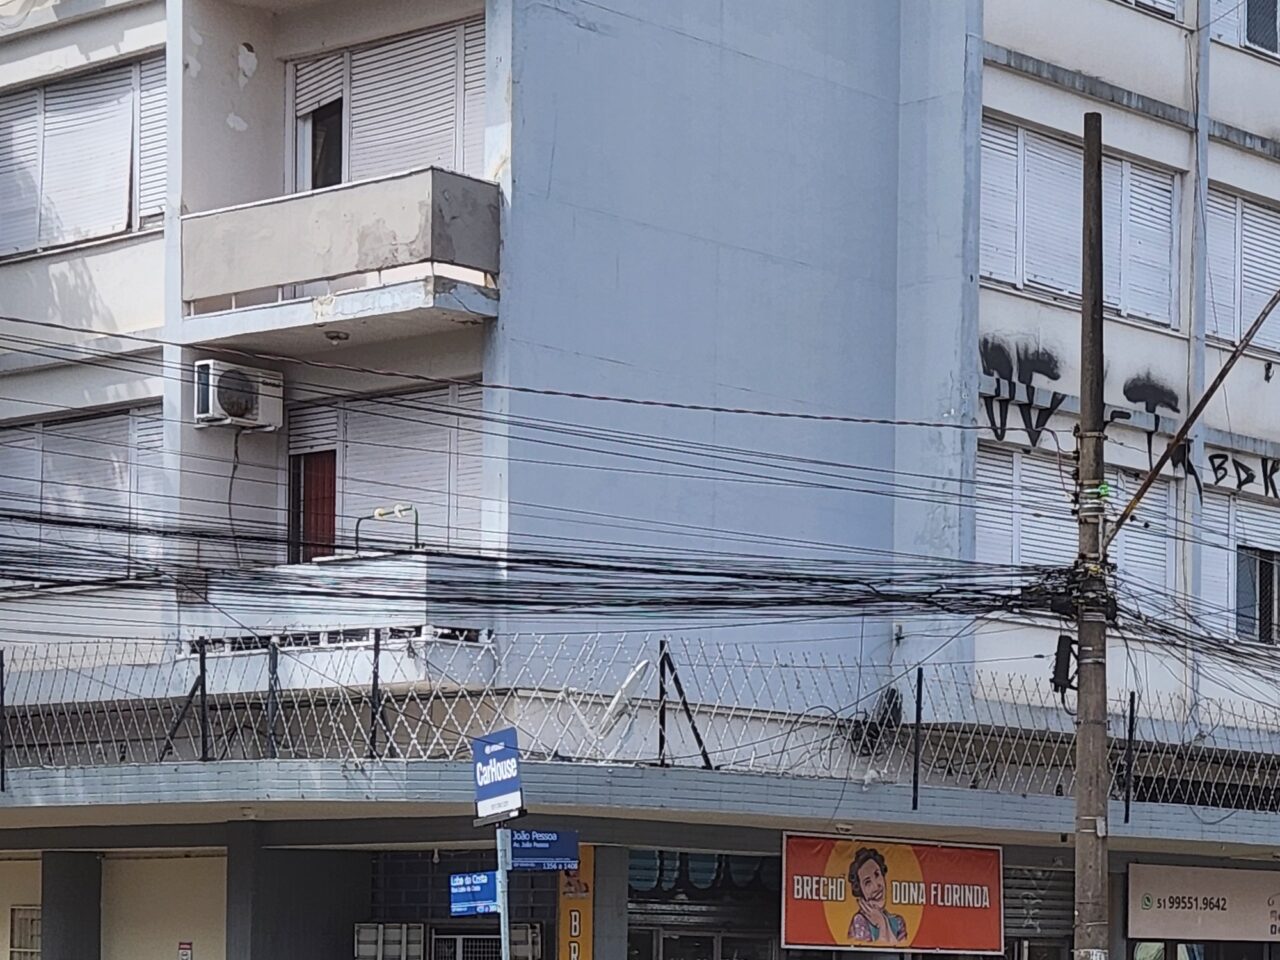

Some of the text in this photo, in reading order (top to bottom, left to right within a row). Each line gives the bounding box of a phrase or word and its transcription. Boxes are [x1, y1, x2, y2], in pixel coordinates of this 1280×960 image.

[476, 757, 518, 787] CarHouse
[512, 830, 557, 841] João Pessoa
[793, 873, 990, 908] BRECHÓ DONA FLORINDA
[1157, 896, 1227, 911] 51 99551.9642
